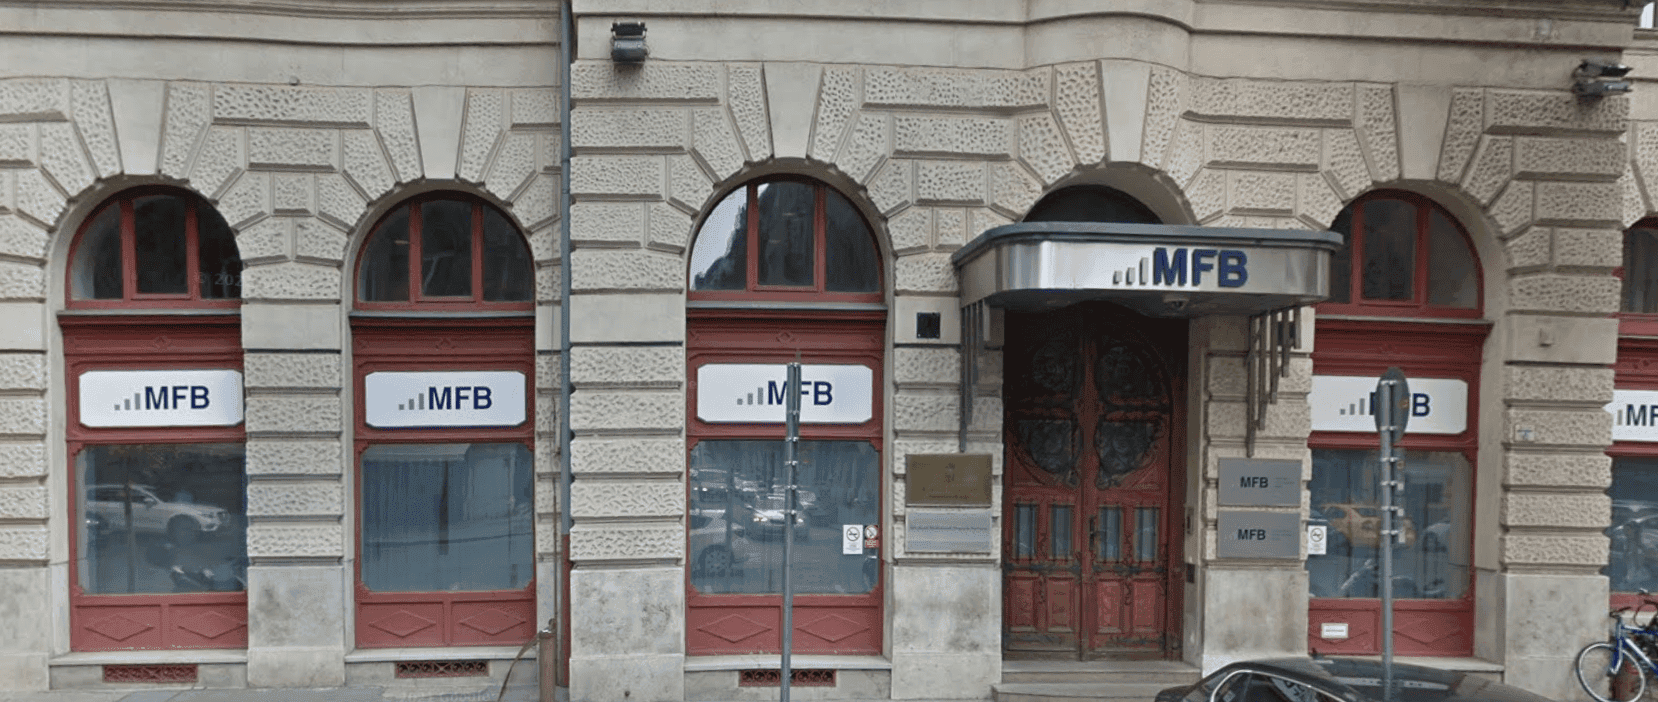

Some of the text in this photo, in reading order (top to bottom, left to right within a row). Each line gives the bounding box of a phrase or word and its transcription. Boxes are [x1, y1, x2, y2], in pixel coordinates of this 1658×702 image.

[1153, 247, 1248, 288] MFB
[145, 386, 210, 410] MFB
[428, 386, 493, 410] MFB
[1240, 476, 1269, 488] MFB
[1237, 528, 1266, 541] MFB
